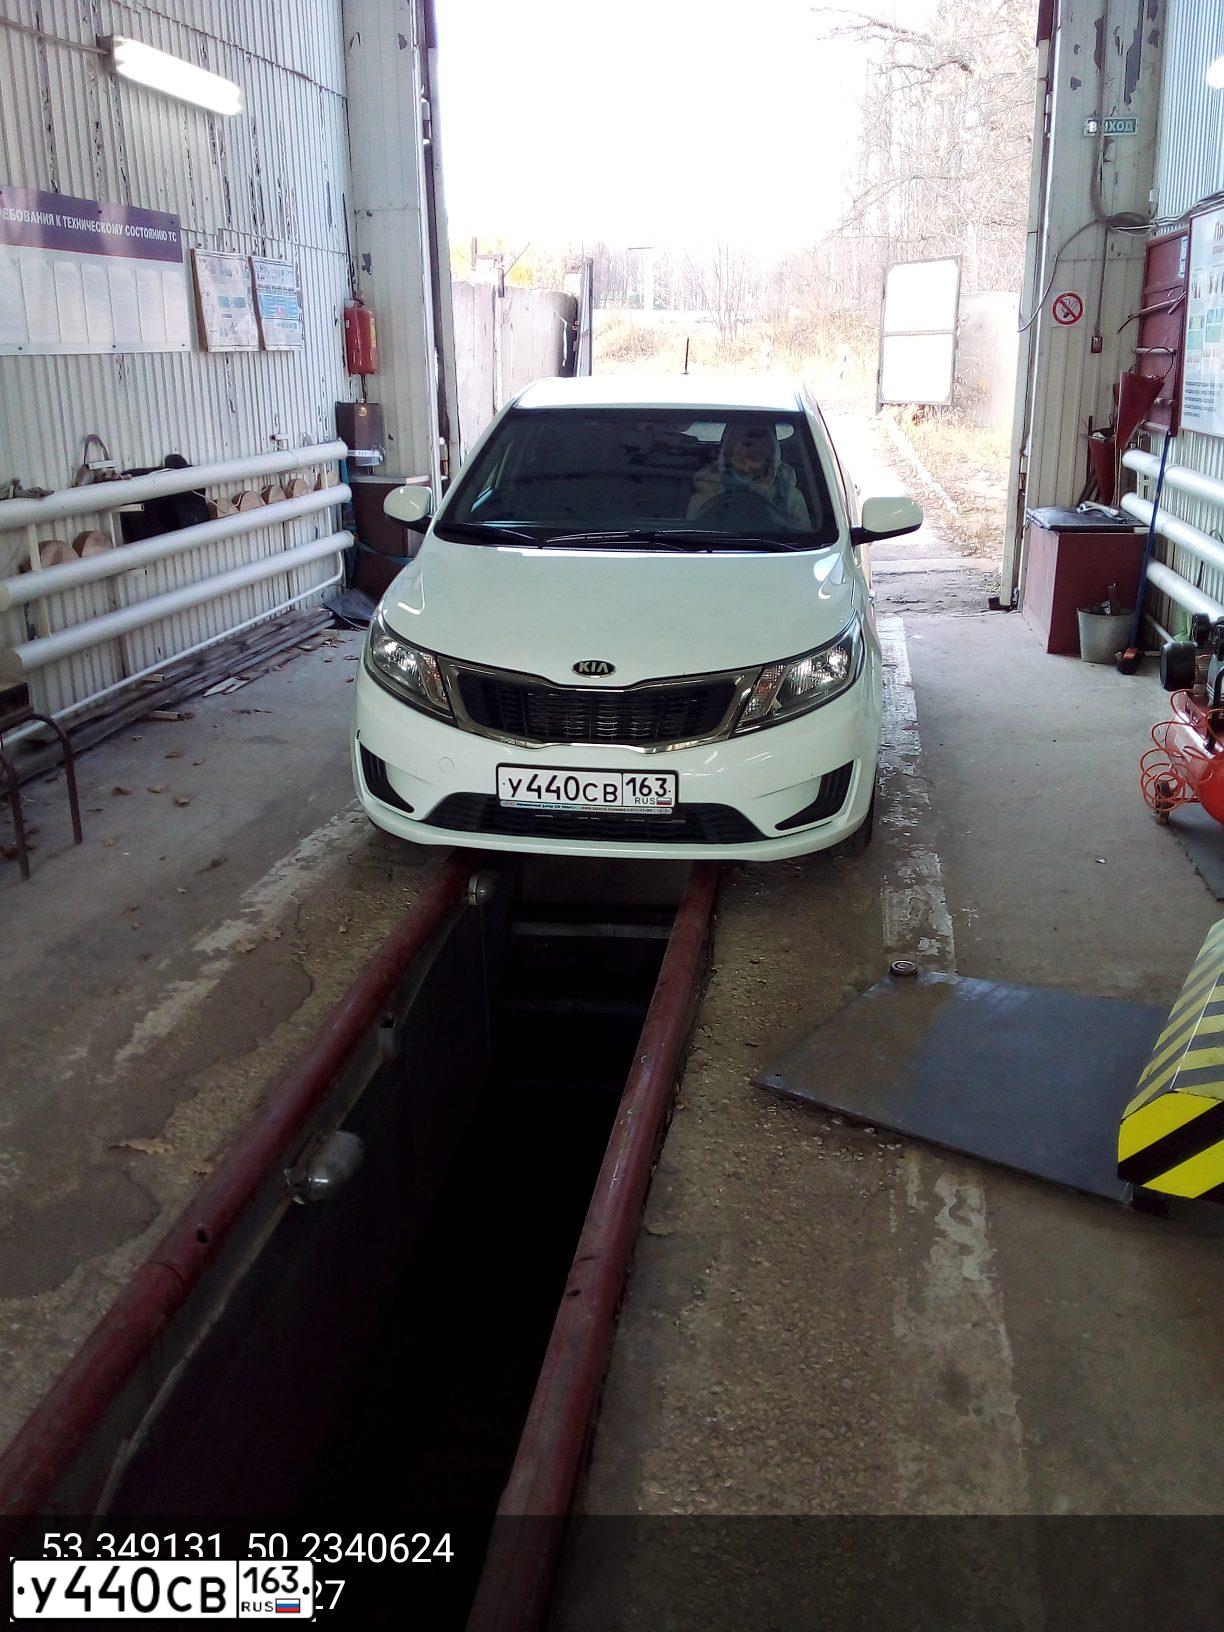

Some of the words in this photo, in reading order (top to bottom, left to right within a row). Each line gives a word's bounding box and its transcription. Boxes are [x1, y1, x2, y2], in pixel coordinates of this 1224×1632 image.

[1089, 120, 1133, 132] ВХОД
[55, 214, 62, 227] К
[62, 215, 123, 236] ТЕХНИЧЕСКОМУ
[124, 224, 168, 241] СОСТОЯНИЮ
[167, 230, 177, 243] ТС
[579, 661, 609, 673] KIA
[508, 773, 618, 803] У440СВ
[625, 777, 668, 797] 163
[635, 796, 656, 805] RUS
